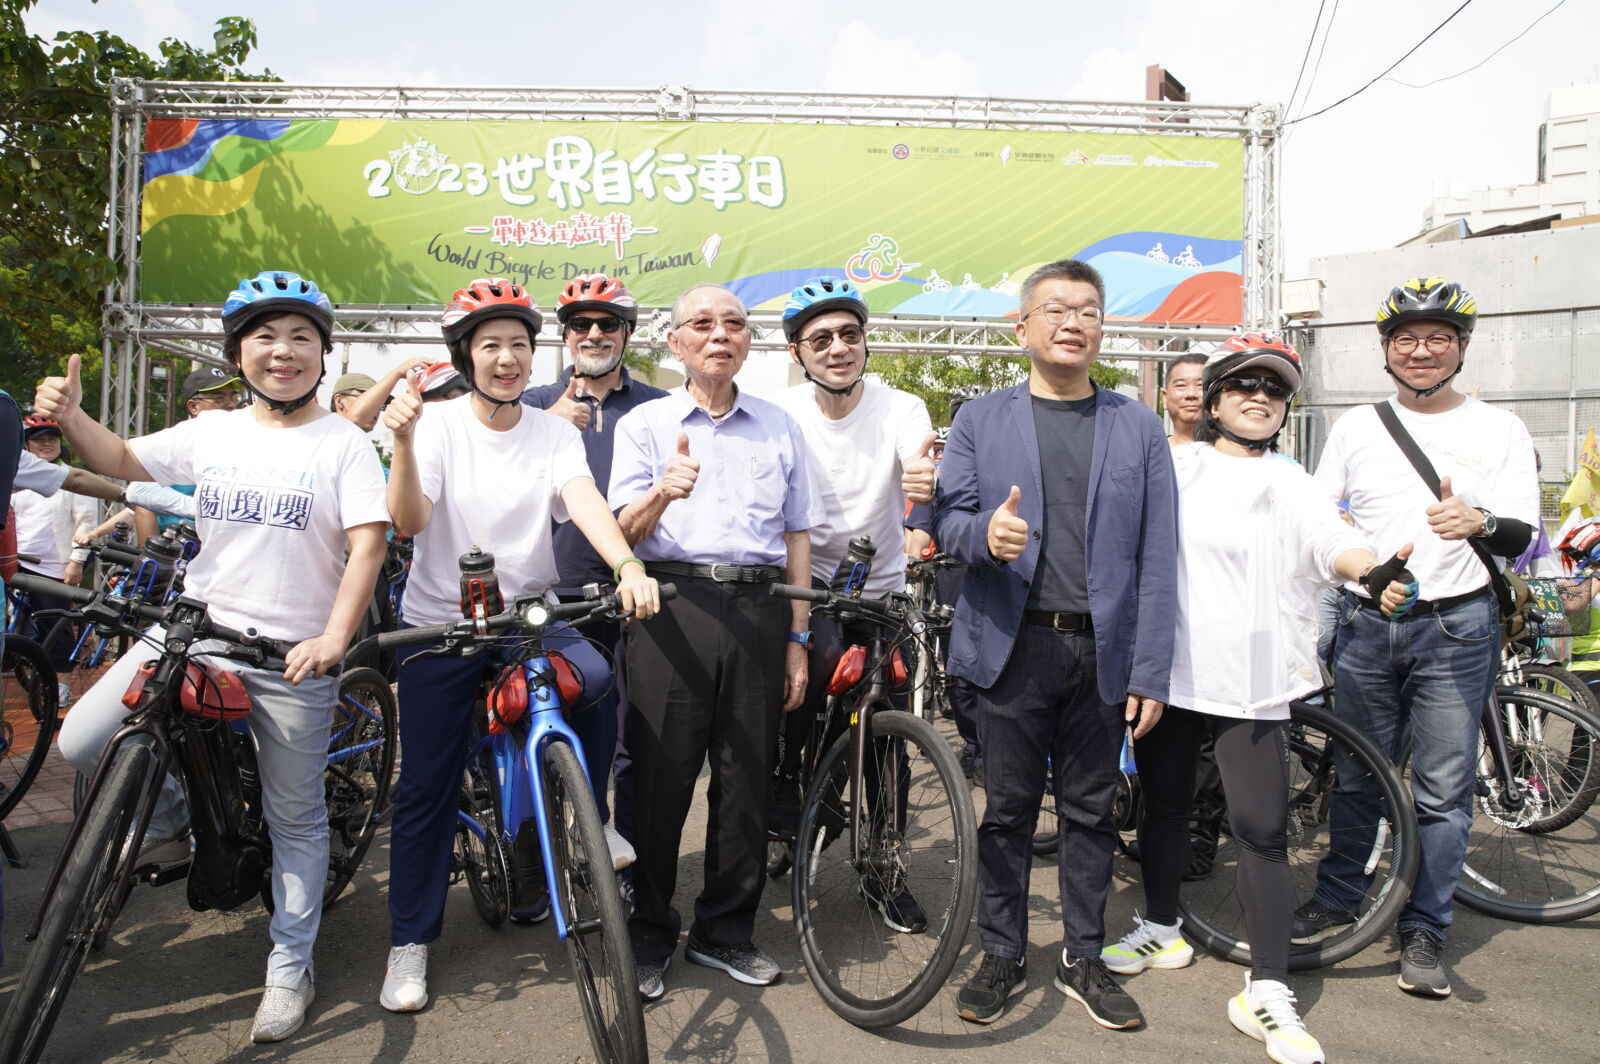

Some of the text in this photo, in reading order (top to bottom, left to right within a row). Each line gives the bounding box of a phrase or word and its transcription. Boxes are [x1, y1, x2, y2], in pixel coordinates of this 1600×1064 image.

[428, 233, 481, 270] World
[484, 251, 555, 285] Bicycle
[613, 263, 630, 277] in
[626, 250, 702, 275] Taiwan
